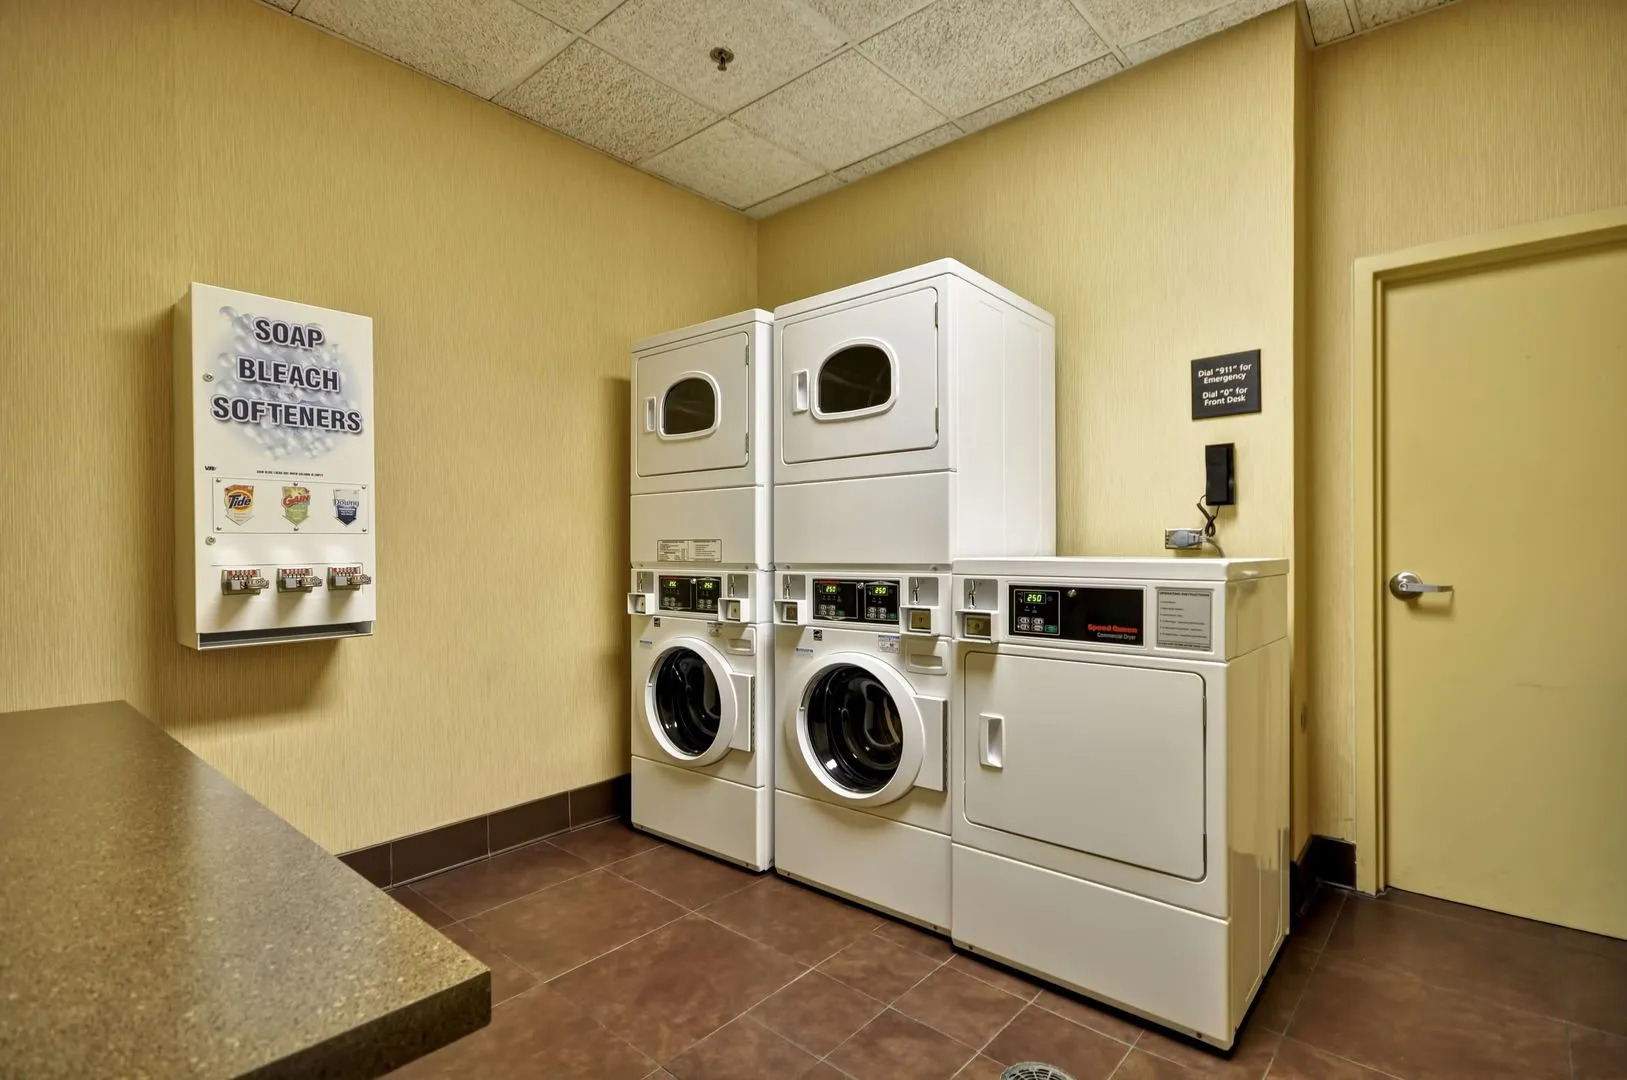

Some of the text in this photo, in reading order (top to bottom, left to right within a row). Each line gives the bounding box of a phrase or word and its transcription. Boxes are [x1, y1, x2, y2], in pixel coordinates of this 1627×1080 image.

[254, 318, 324, 349] SOAP
[238, 357, 339, 391] BLEACH
[1198, 369, 1214, 377] Dial
[1203, 372, 1247, 384] Emergency
[1202, 390, 1218, 399] Dial
[1204, 394, 1246, 406] Front Desk
[212, 396, 362, 432] SOFTENERS
[228, 494, 252, 509] Tide
[1027, 594, 1042, 602] 250
